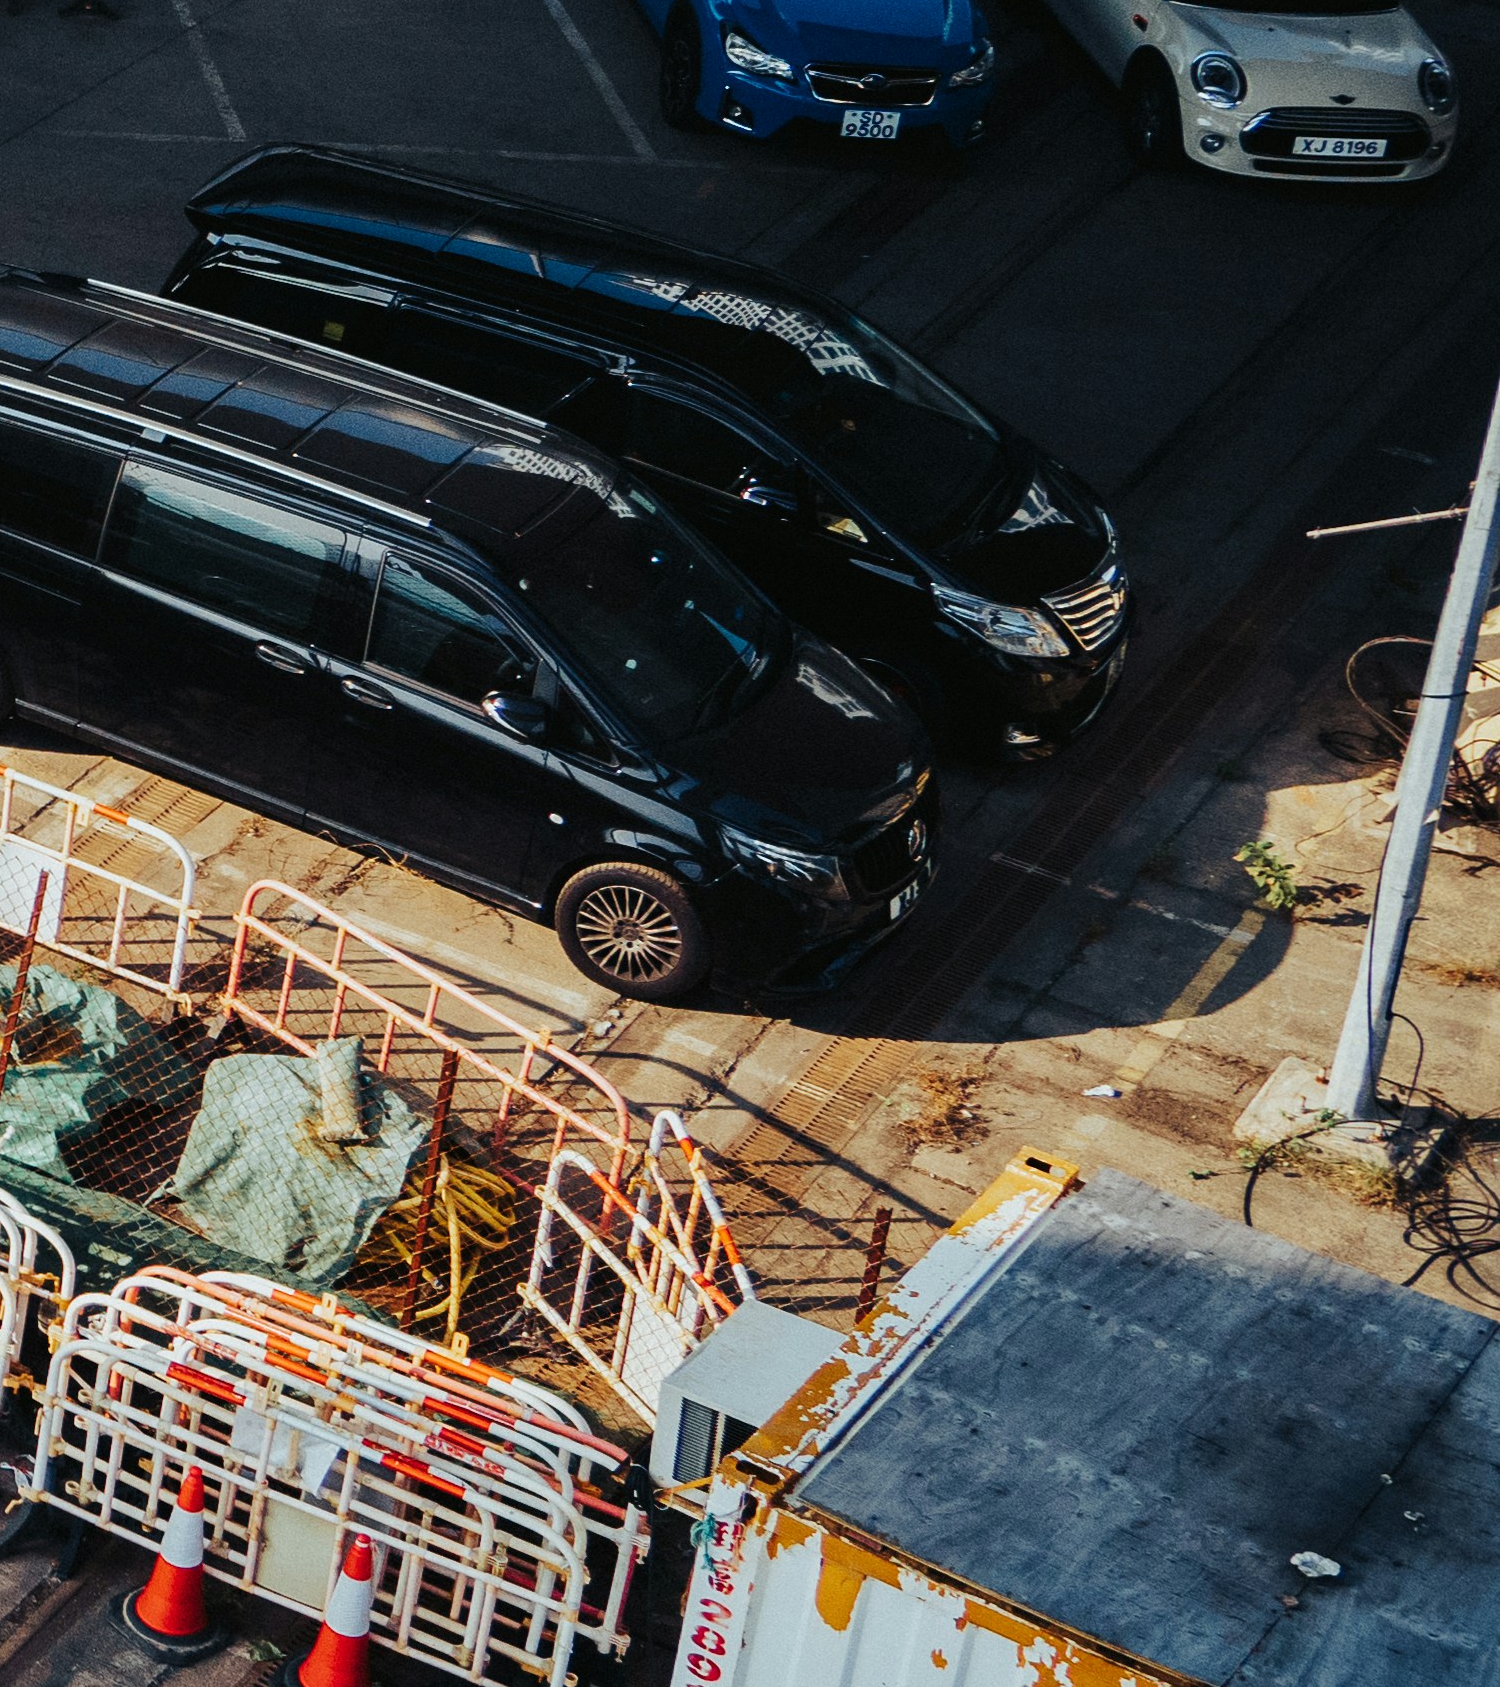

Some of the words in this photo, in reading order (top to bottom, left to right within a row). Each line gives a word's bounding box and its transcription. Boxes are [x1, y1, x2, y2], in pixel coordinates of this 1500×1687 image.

[859, 112, 884, 124] SD
[1301, 139, 1328, 153] XJ
[1332, 140, 1379, 154] 8196
[686, 1598, 733, 1687] 289
